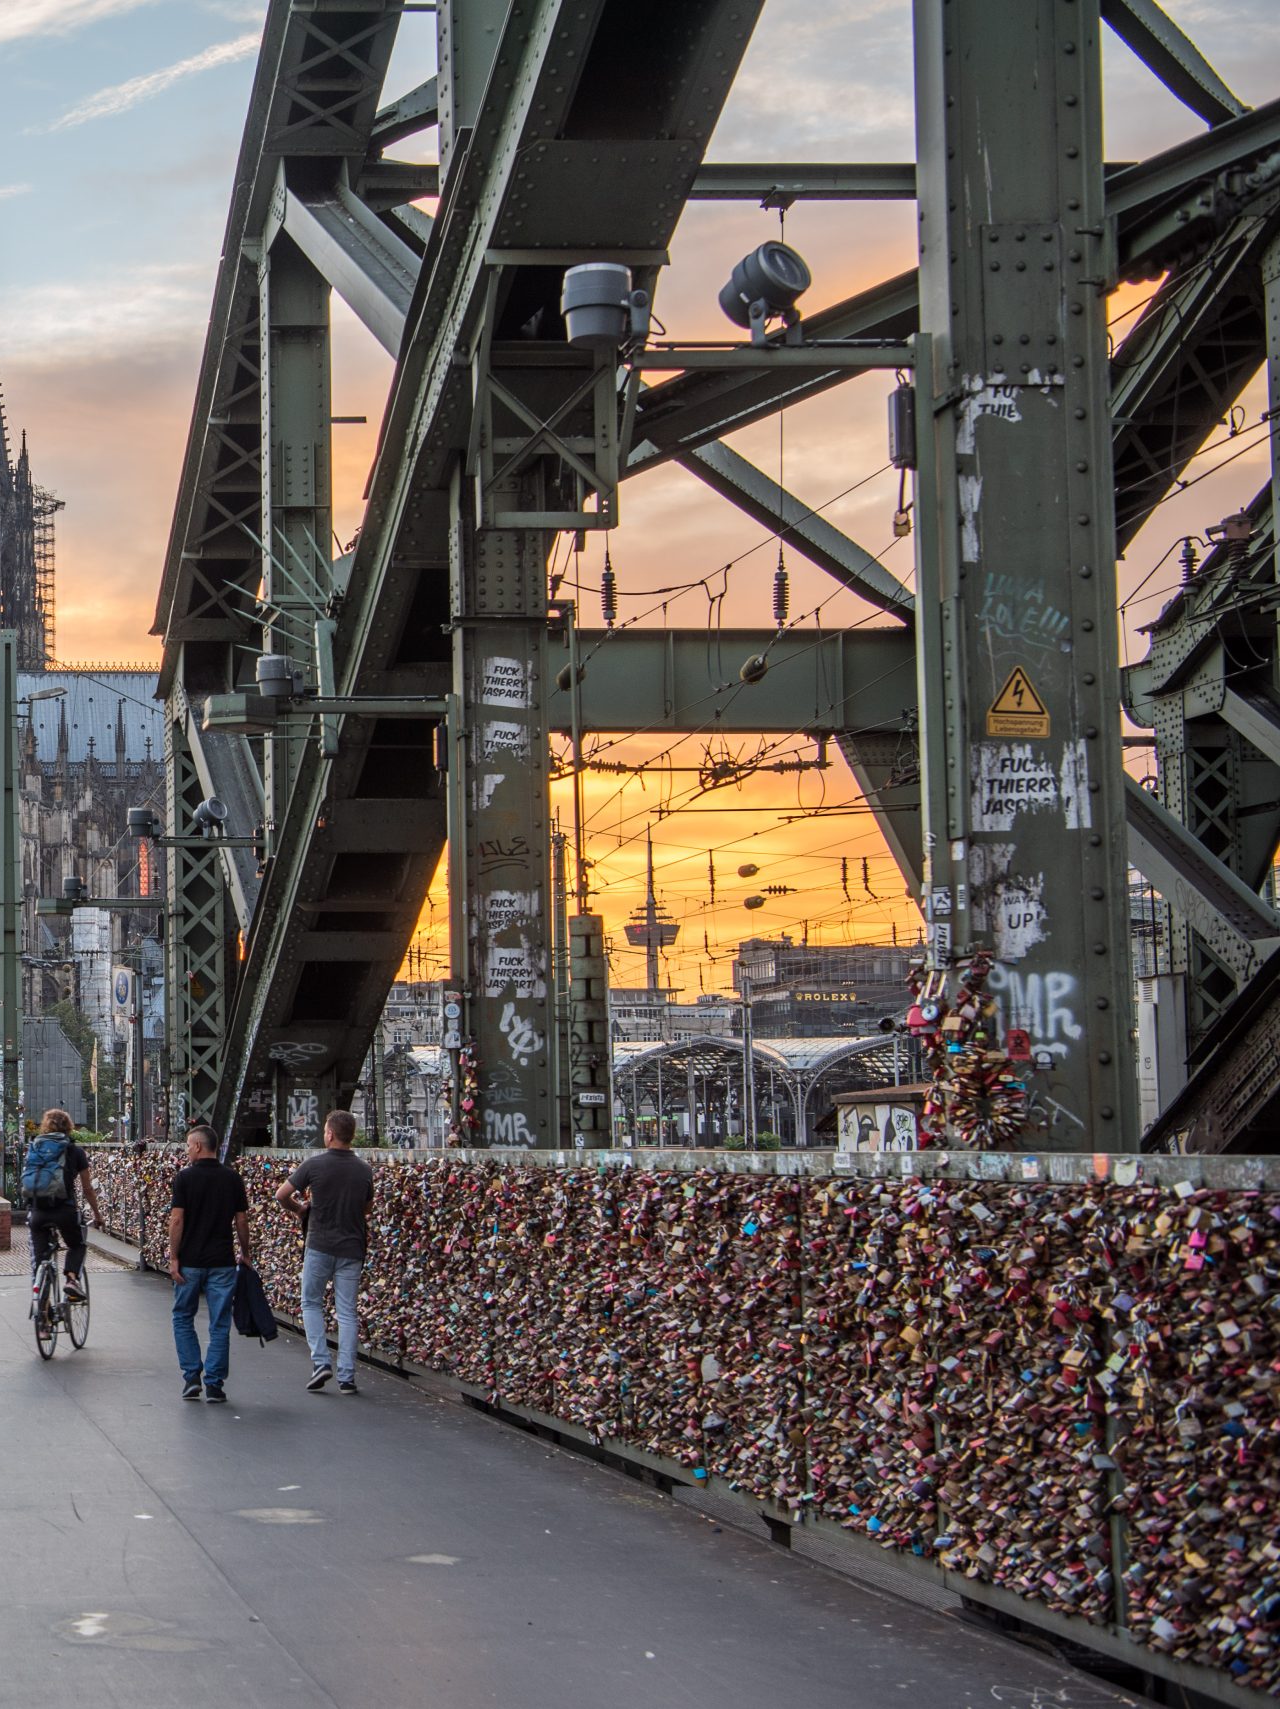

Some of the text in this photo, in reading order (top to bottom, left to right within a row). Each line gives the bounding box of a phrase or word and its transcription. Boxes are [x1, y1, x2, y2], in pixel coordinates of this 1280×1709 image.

[992, 385, 1013, 399] FU
[494, 665, 520, 676] FUCK
[485, 676, 527, 688] THIERRY
[993, 718, 1043, 727] Hochspannung
[995, 725, 1041, 734] Lebensgefahr
[493, 730, 520, 740] FUCK
[490, 898, 516, 908] FUCK
[498, 956, 524, 966] FUCK
[490, 968, 533, 977] THIERRY
[486, 979, 536, 989] JASART!
[804, 993, 848, 1001] ROLEX
